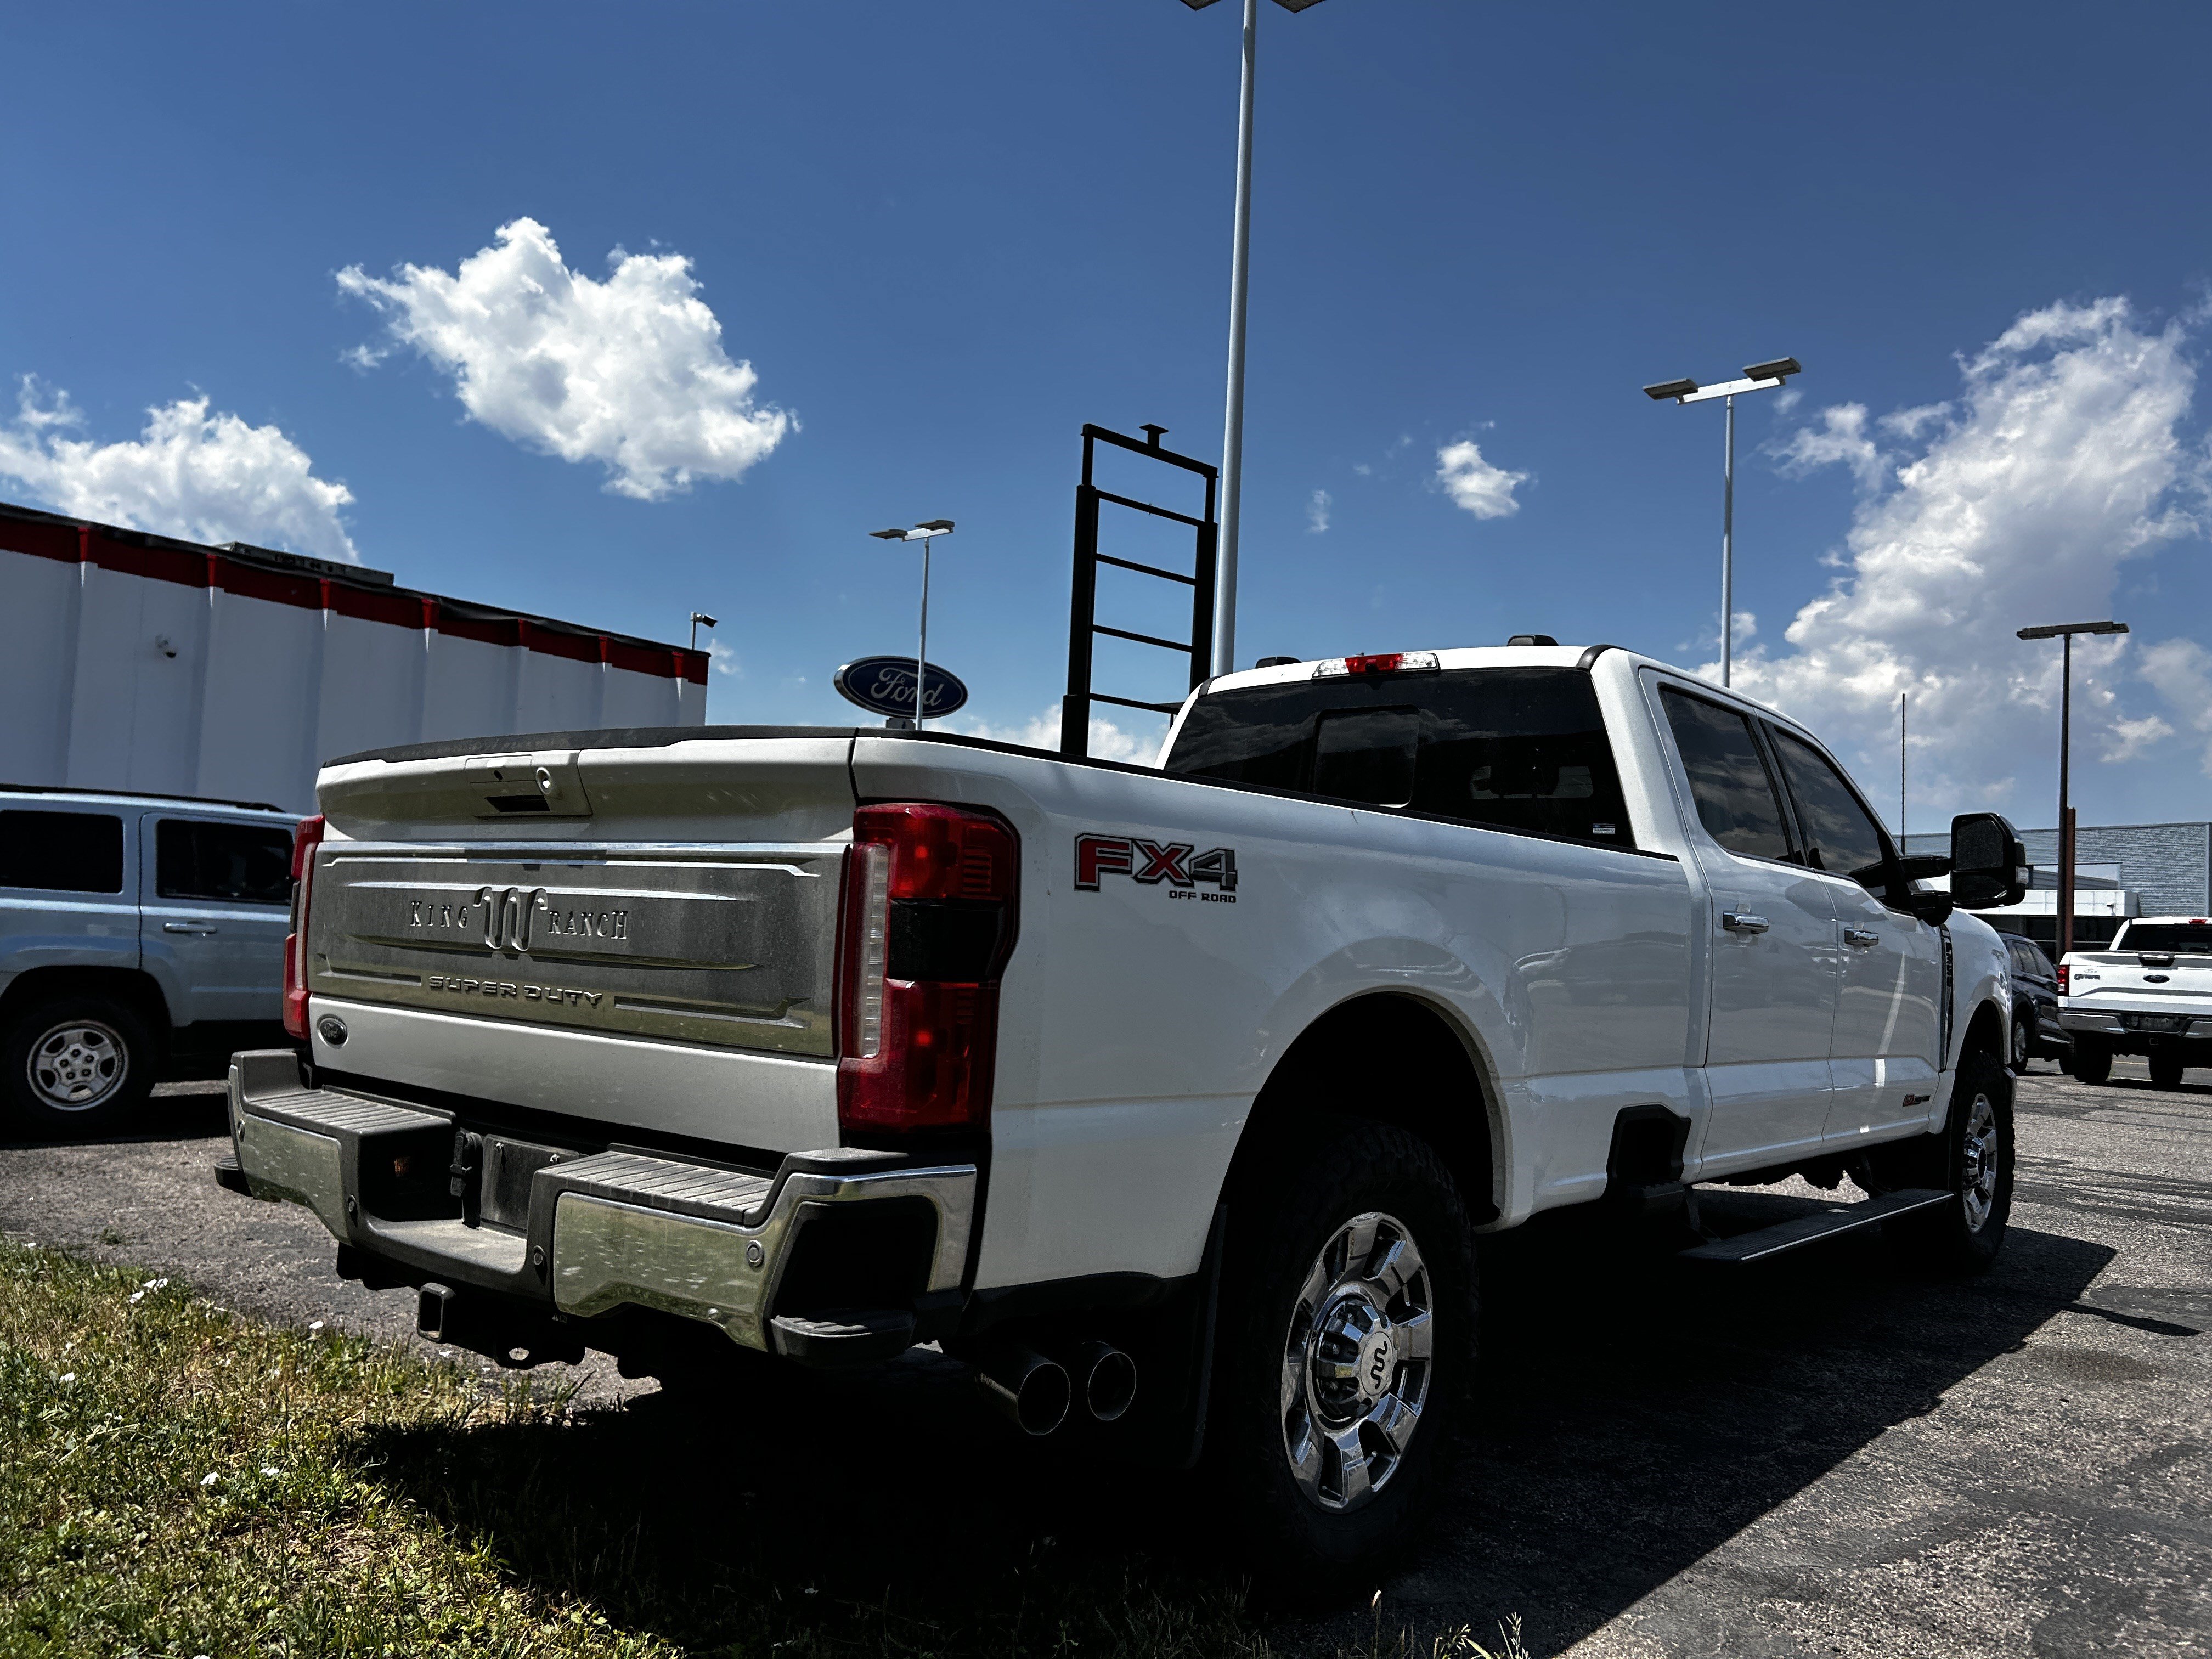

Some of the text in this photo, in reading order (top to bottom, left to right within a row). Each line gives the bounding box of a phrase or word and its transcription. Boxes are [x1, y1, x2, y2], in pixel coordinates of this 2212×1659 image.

[871, 668, 944, 706] Ford
[1074, 832, 1238, 891] FX4
[1169, 890, 1237, 903] OFF ROAD
[410, 901, 628, 939] KING RANCH
[429, 976, 603, 1005] SUPER DUTY
[324, 1022, 338, 1038] Ford
